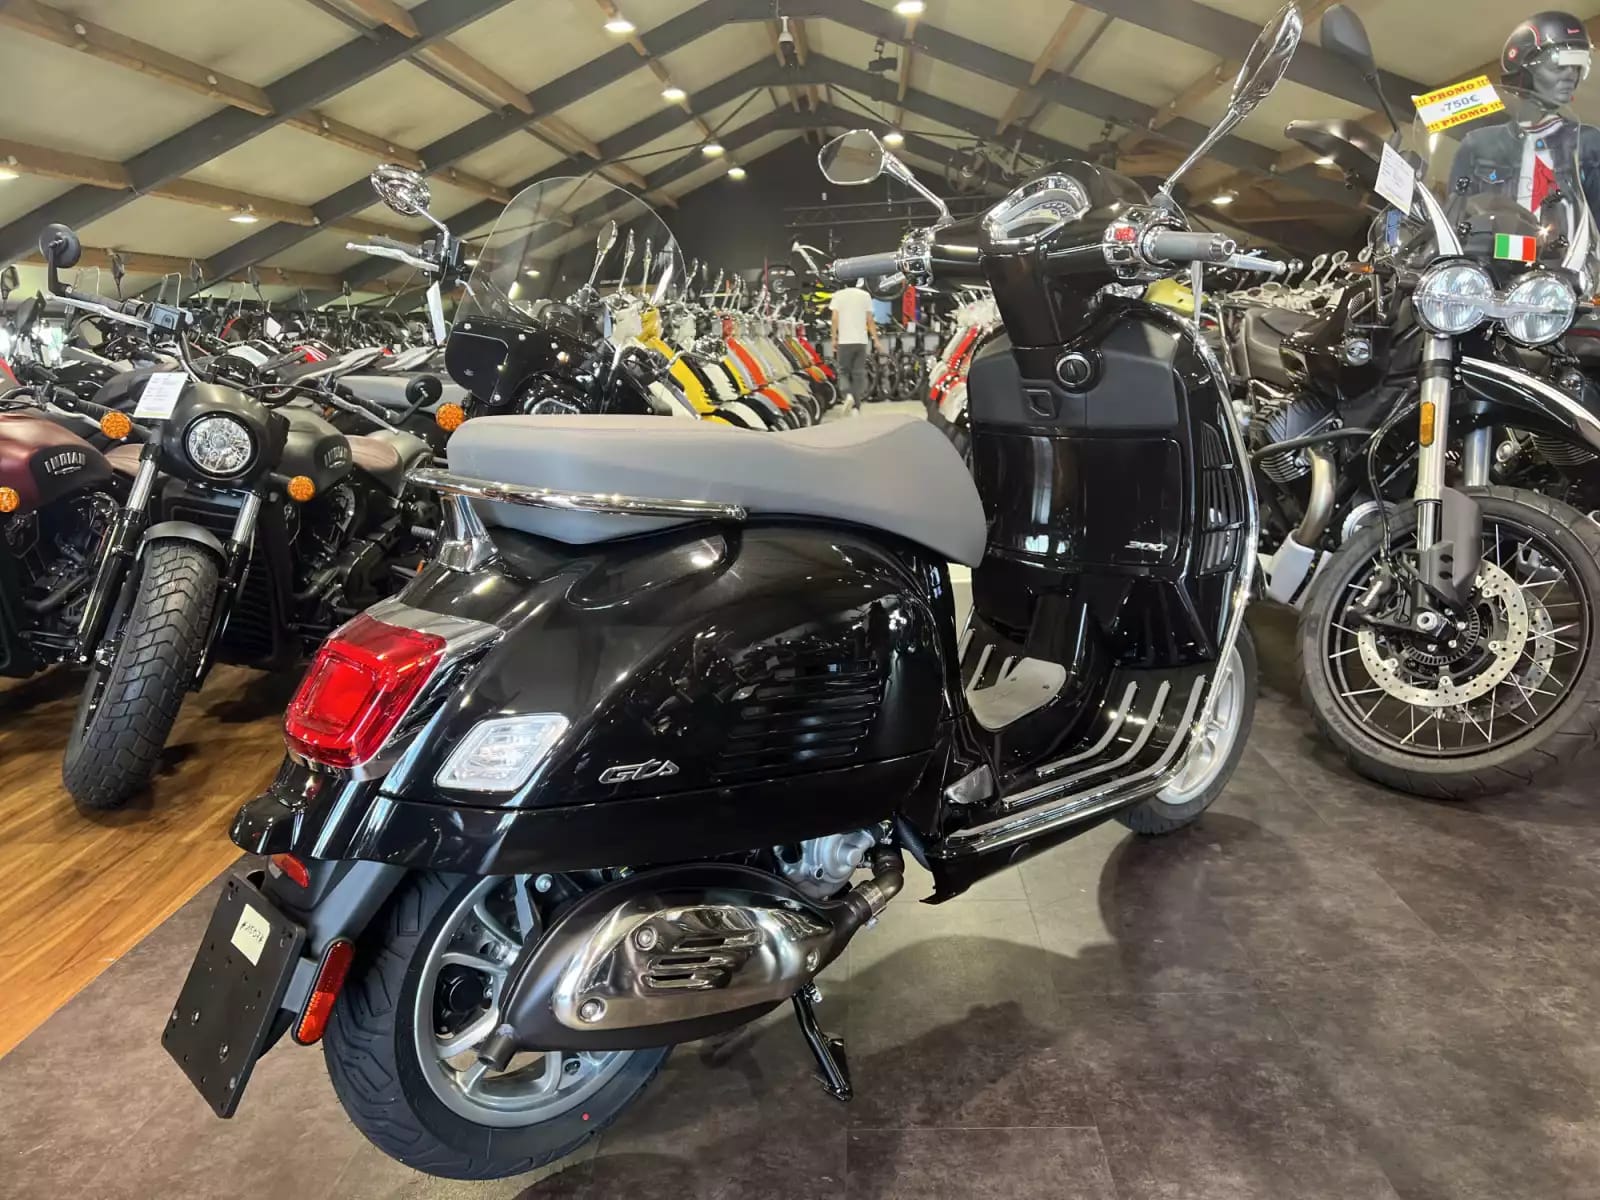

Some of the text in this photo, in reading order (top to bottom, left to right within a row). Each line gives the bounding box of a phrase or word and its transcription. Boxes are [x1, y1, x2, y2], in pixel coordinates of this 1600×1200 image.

[1428, 83, 1475, 104] PROMO
[1441, 106, 1489, 128] PROMO
[44, 451, 87, 474] INDIAN
